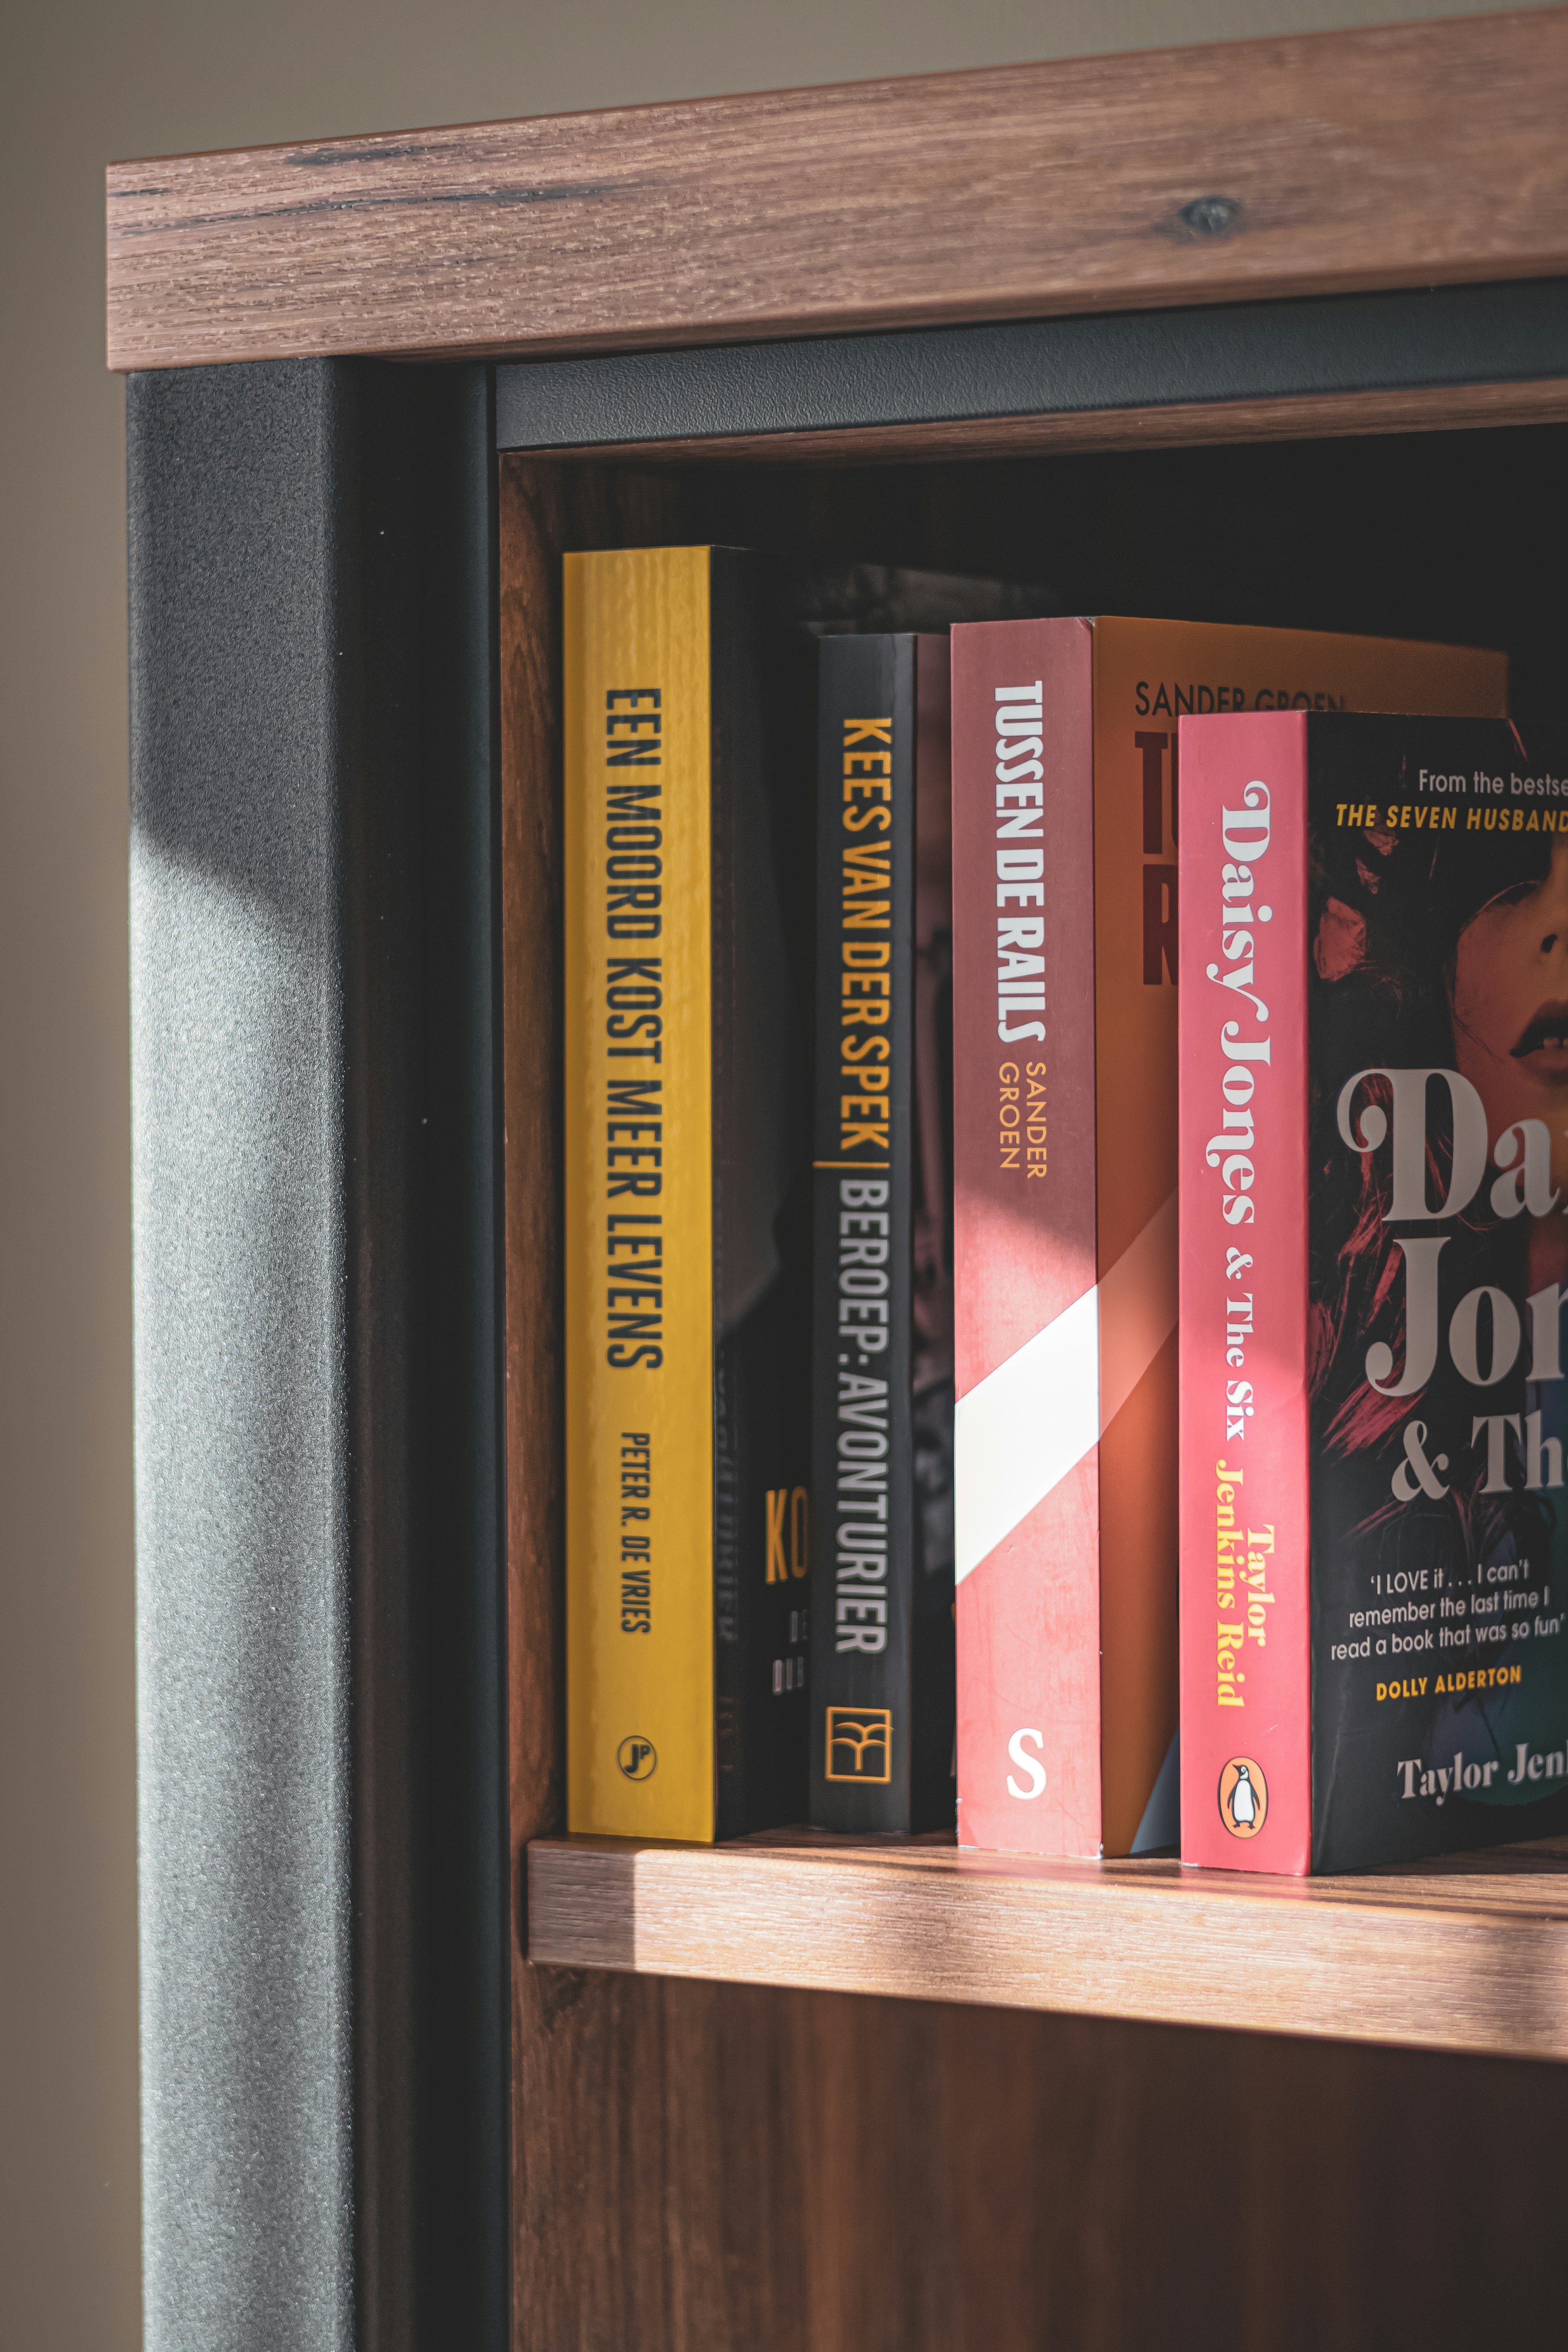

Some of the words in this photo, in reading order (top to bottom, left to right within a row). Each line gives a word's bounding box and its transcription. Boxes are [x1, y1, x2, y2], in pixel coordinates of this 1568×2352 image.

[606, 689, 661, 766] EEN
[995, 680, 1044, 838] TUSSEN
[843, 718, 892, 831] KEES
[1419, 769, 1466, 792] From
[1473, 771, 1504, 794] the
[1336, 804, 1376, 827] THE
[1386, 805, 1457, 829] SEVEN
[606, 785, 662, 939] MOORD
[843, 841, 891, 928] VAN
[997, 849, 1044, 907] DE
[1206, 781, 1272, 1021] Daisy
[606, 958, 662, 1064] KOST
[842, 942, 890, 1025] DER
[998, 917, 1046, 1042] RAILS
[841, 1035, 890, 1149] SPEK
[999, 1062, 1020, 1168] GROEN
[1026, 1062, 1047, 1178] SANDER
[1206, 1021, 1271, 1225] Jones
[607, 1080, 662, 1198] MEER
[606, 1214, 663, 1369] LEVENS
[1226, 1247, 1253, 1279] &
[1226, 1293, 1253, 1367] The
[1227, 1380, 1254, 1440] Six
[621, 1432, 650, 1498] PETER
[1391, 1420, 1449, 1501] &
[621, 1506, 650, 1526] R.
[621, 1536, 650, 1562] DE
[1215, 1459, 1245, 1609] Jenkins
[621, 1571, 651, 1633] VRIES
[1247, 1524, 1274, 1646] Taylor
[1349, 1601, 1435, 1628] remember
[1440, 1597, 1466, 1617] the
[1471, 1592, 1499, 1614] last
[1503, 1590, 1539, 1610] time
[1544, 1586, 1549, 1606] I
[1387, 1570, 1428, 1594] LOVE
[1434, 1568, 1443, 1588] it
[1478, 1564, 1482, 1584] I
[1217, 1621, 1245, 1707] Reid
[1332, 1637, 1370, 1660] read
[1376, 1640, 1386, 1655] a
[1392, 1630, 1433, 1653] book
[1439, 1624, 1470, 1647] that
[1475, 1625, 1507, 1642] was
[1512, 1622, 1530, 1640] so
[1376, 1677, 1427, 1701] DOLLY
[1435, 1665, 1521, 1693] ALDERTON
[1397, 1752, 1499, 1805] Taylor
[1507, 1738, 1568, 1785] Jen
